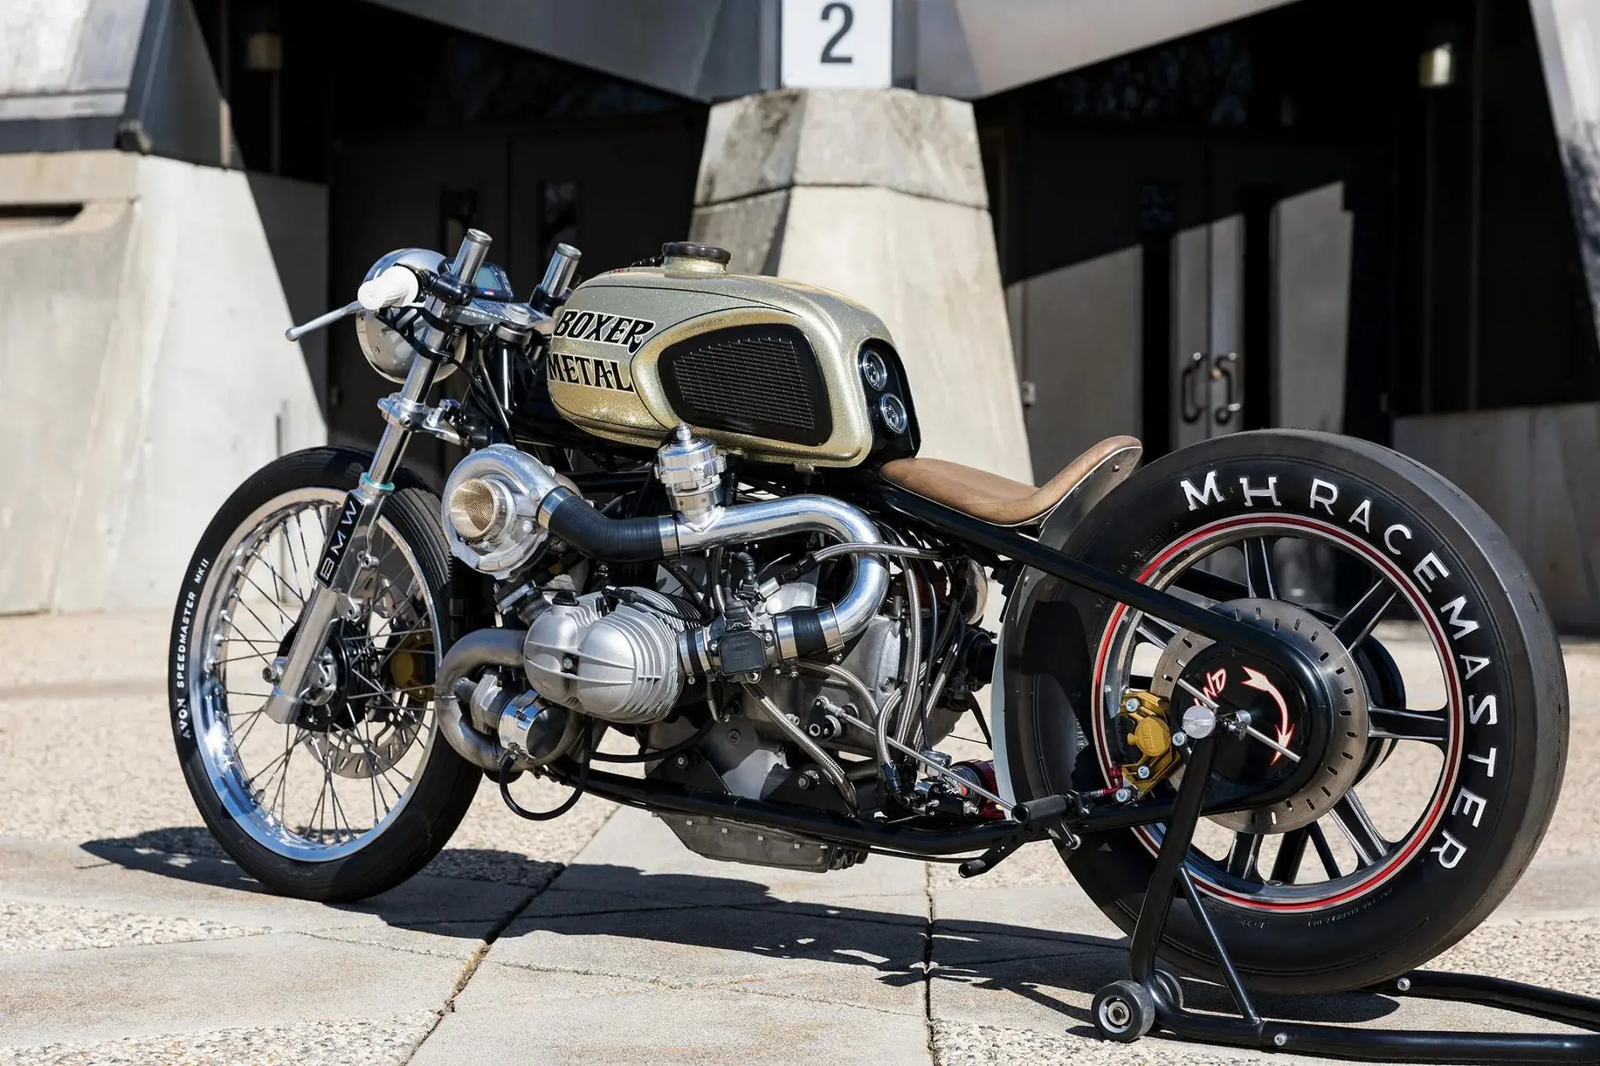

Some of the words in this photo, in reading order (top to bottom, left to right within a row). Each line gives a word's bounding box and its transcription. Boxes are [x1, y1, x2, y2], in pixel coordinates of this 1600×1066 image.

[820, 2, 853, 63] 2
[553, 309, 656, 355] BOXER
[547, 353, 635, 394] METAL
[319, 500, 357, 581] BMW
[176, 591, 197, 689] SPEEDMASTER
[1309, 478, 1498, 869] RACEMASTER
[176, 698, 191, 739] AVON
